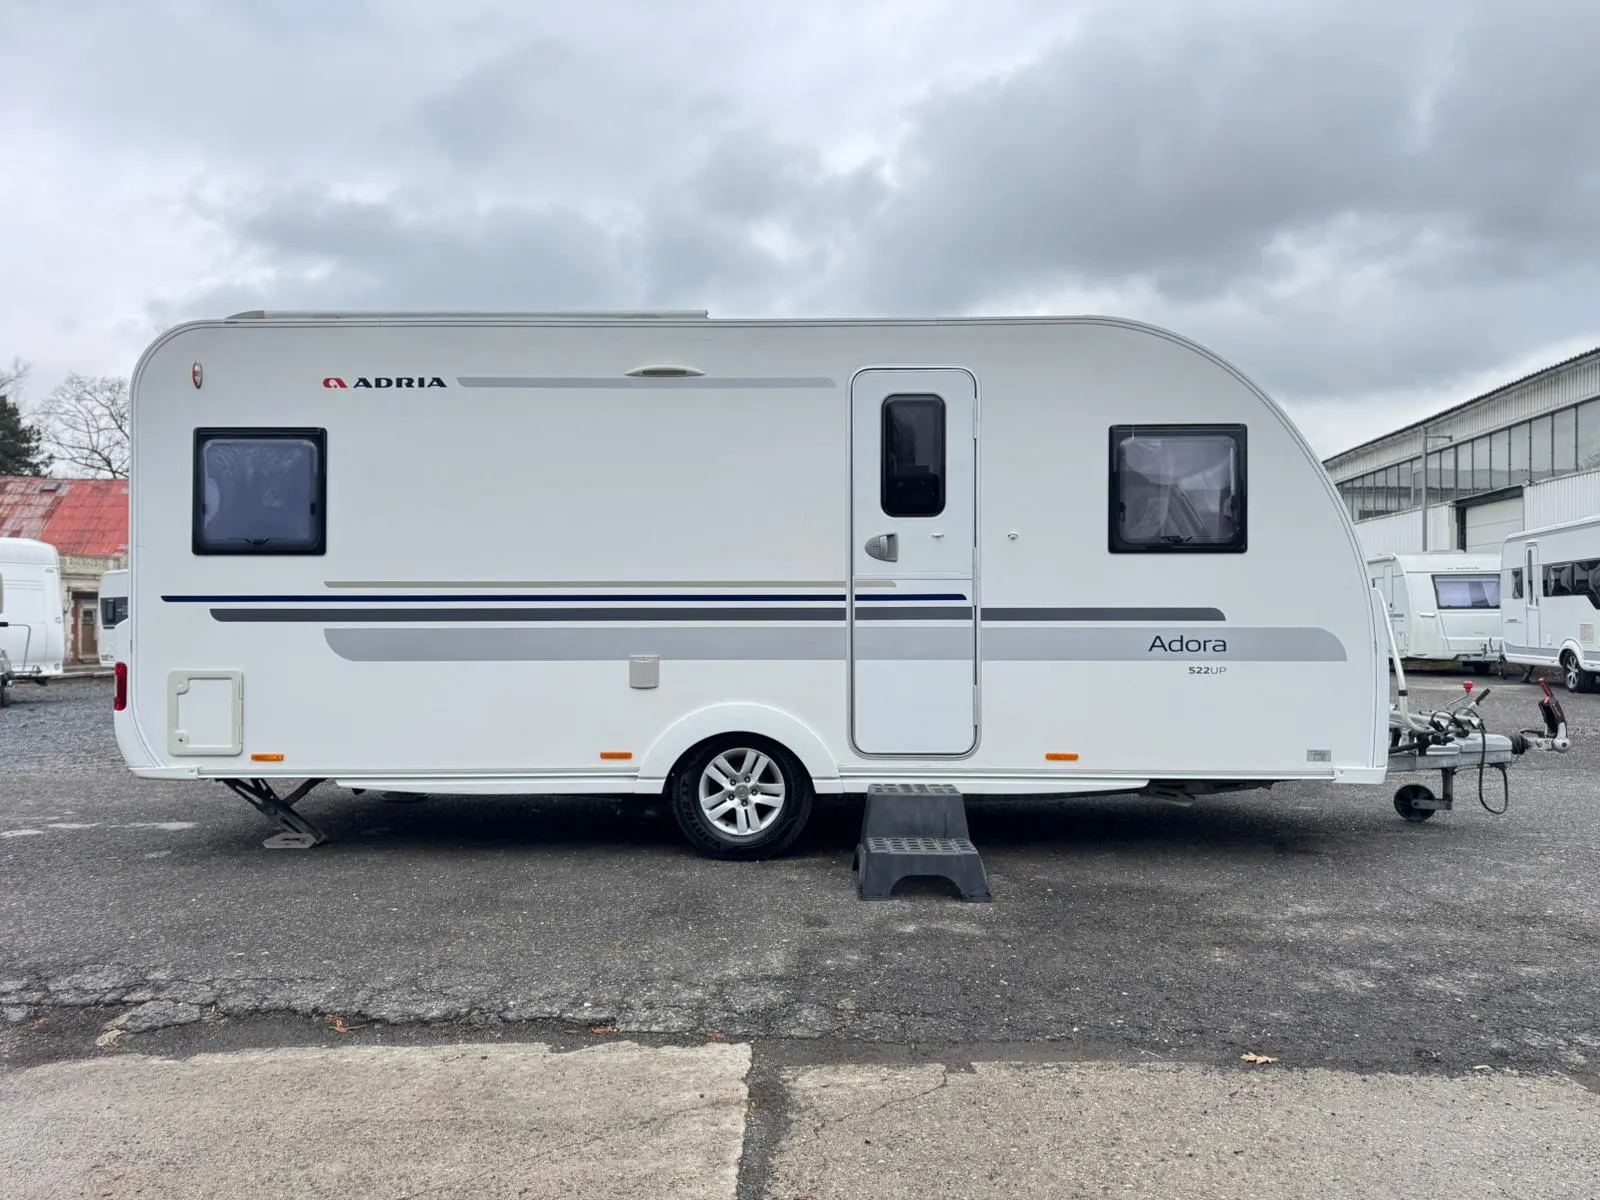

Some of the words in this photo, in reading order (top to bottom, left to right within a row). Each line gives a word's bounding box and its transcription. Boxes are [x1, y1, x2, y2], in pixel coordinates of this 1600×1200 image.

[353, 377, 447, 388] ADRIA
[1148, 635, 1227, 652] Adora
[1188, 666, 1227, 675] 522UP
